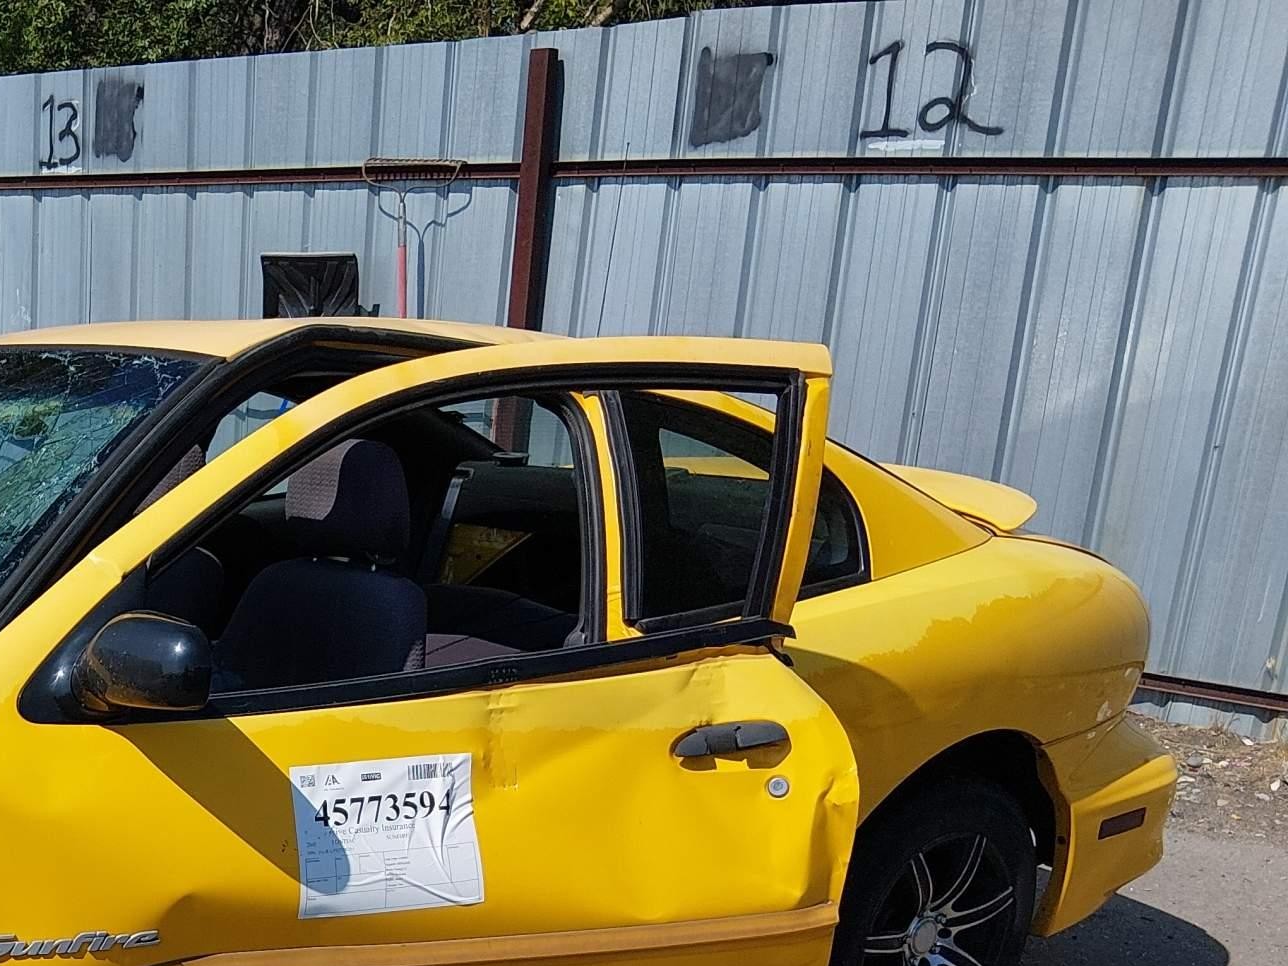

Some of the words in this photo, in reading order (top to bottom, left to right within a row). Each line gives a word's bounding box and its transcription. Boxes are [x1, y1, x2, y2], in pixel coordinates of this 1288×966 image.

[860, 40, 1004, 139] 12
[39, 93, 80, 169] 13
[314, 789, 453, 827] 45773594
